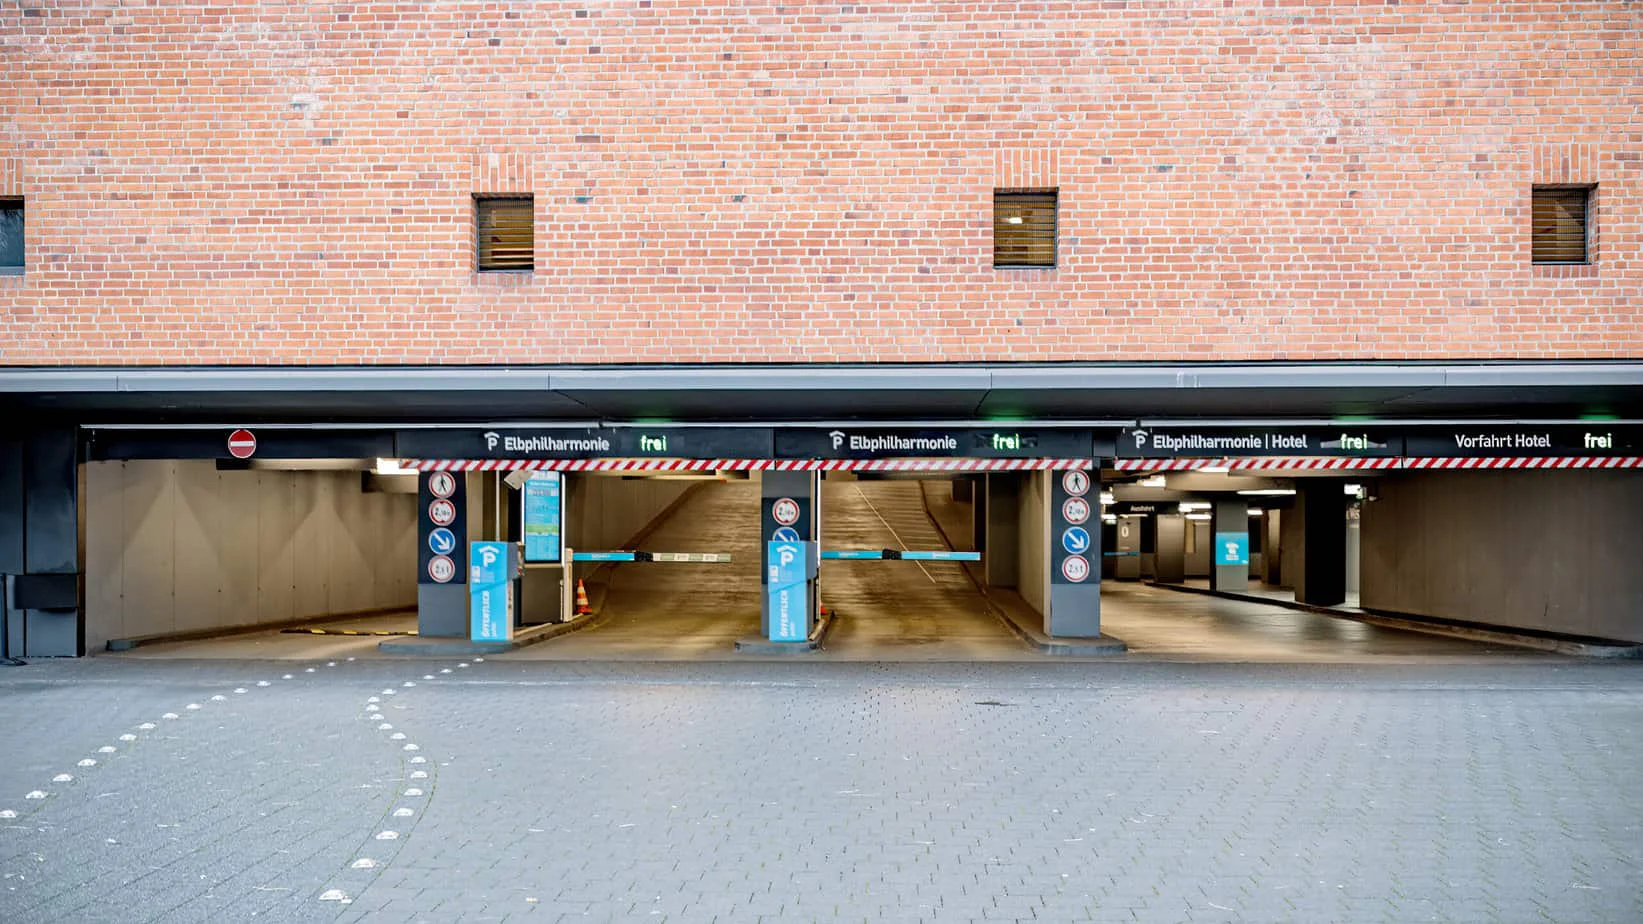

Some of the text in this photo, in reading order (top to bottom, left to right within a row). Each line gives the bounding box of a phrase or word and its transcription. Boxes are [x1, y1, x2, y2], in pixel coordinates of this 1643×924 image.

[504, 436, 610, 453] Elbphilharmonie
[640, 435, 667, 451] frei
[850, 435, 957, 452] Elbphilharmonie
[992, 433, 1020, 450] frei
[1153, 434, 1262, 451] Elbphilharmonie
[1272, 434, 1308, 449] Hotel
[1340, 433, 1368, 449] frei
[1455, 433, 1551, 448] Vorfahrt Hotel
[1584, 433, 1612, 449] frei
